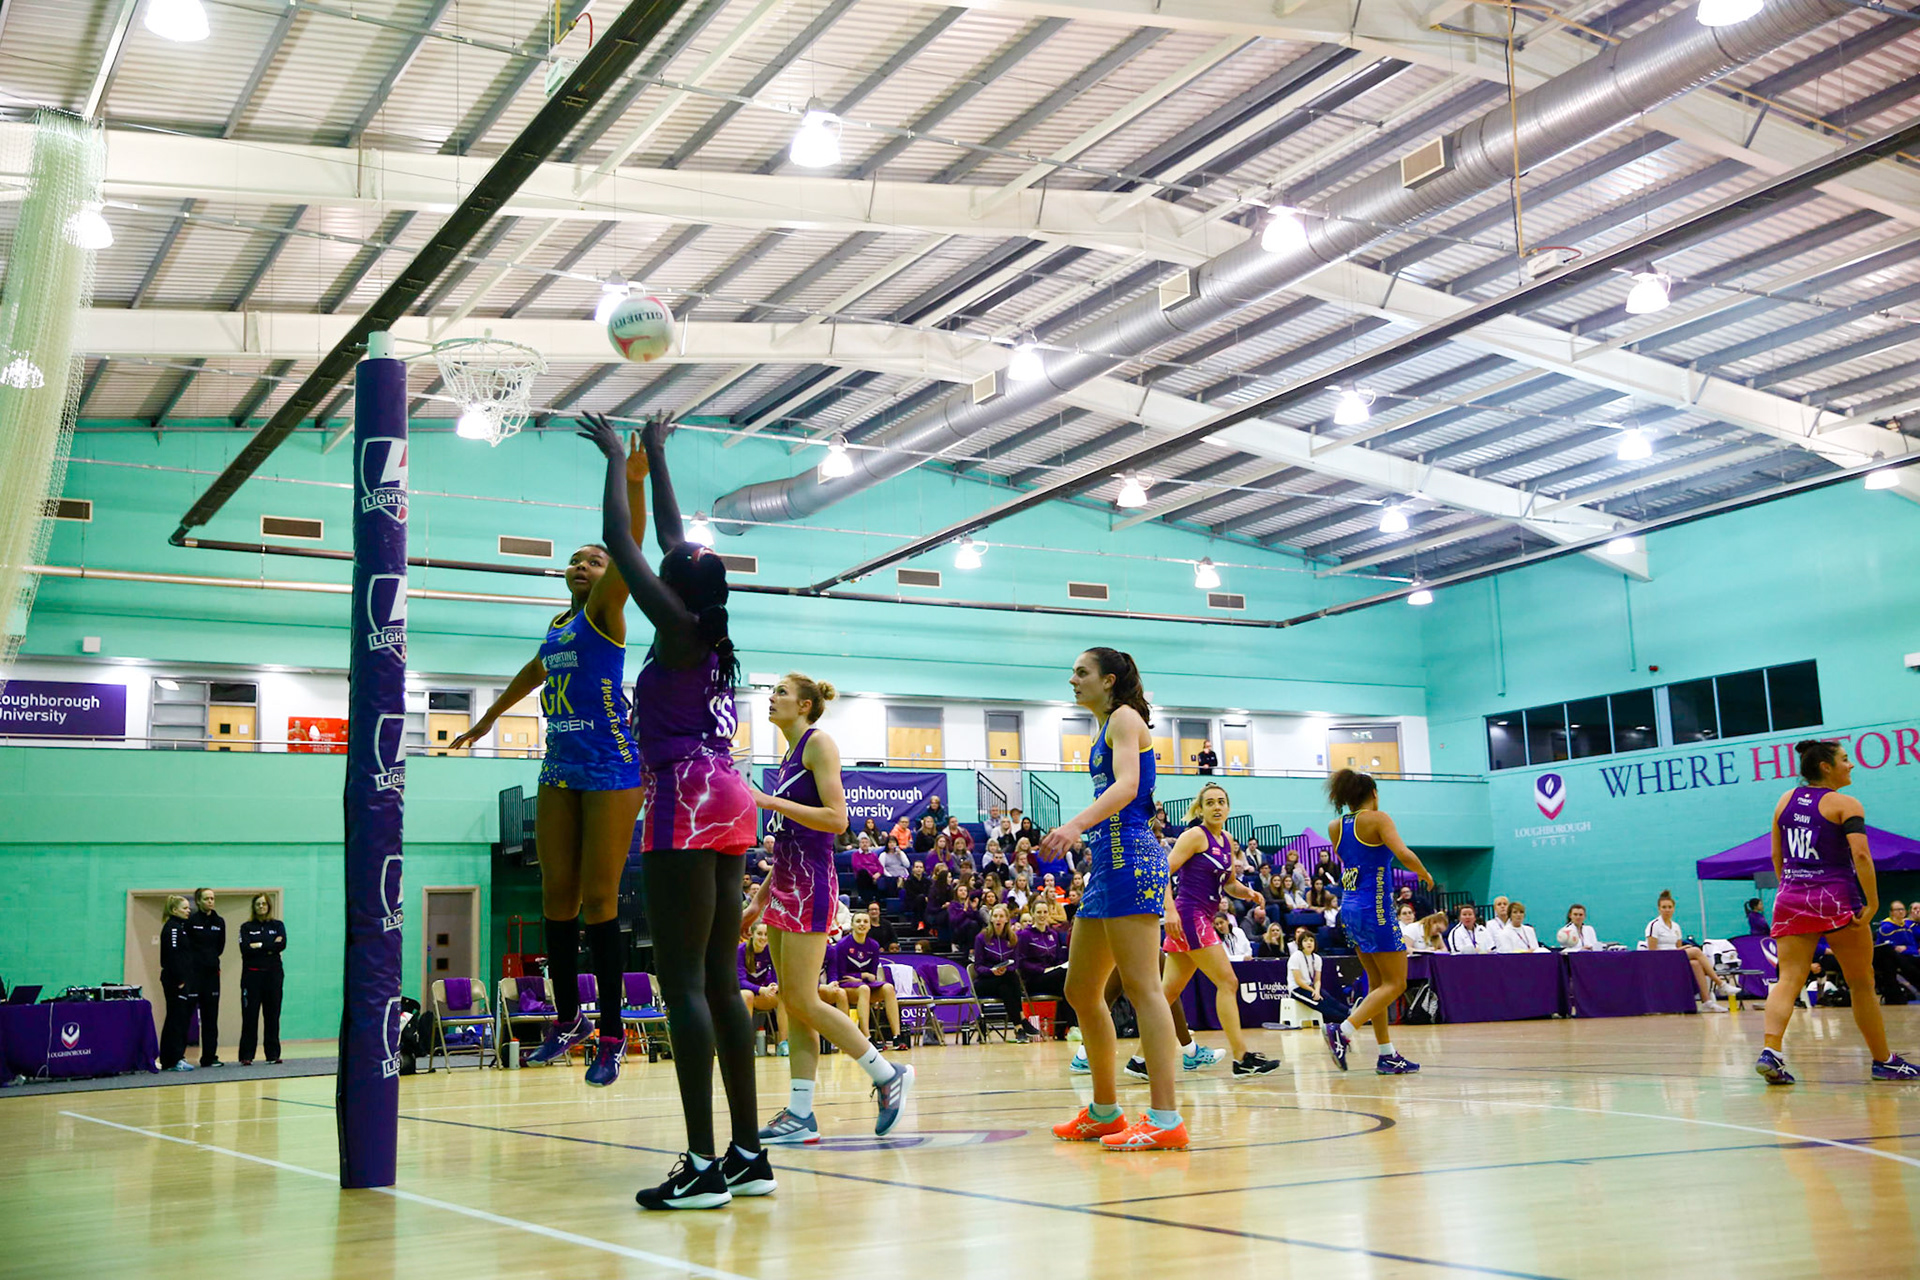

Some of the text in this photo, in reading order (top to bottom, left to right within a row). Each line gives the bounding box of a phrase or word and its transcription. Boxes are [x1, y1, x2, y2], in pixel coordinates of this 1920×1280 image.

[614, 311, 663, 329] GILBERT
[547, 650, 578, 665] SPORTING
[0, 693, 100, 711] oughborough
[541, 673, 575, 716] GK
[1599, 727, 1920, 799] WHERE HIOR
[843, 785, 923, 804] ughborough
[845, 803, 893, 821] iversity
[1514, 821, 1592, 838] LOUGHBOROUGH
[1531, 835, 1576, 848] SPORT
[1258, 982, 1288, 993] Loughbo
[1260, 991, 1291, 1000] Universi
